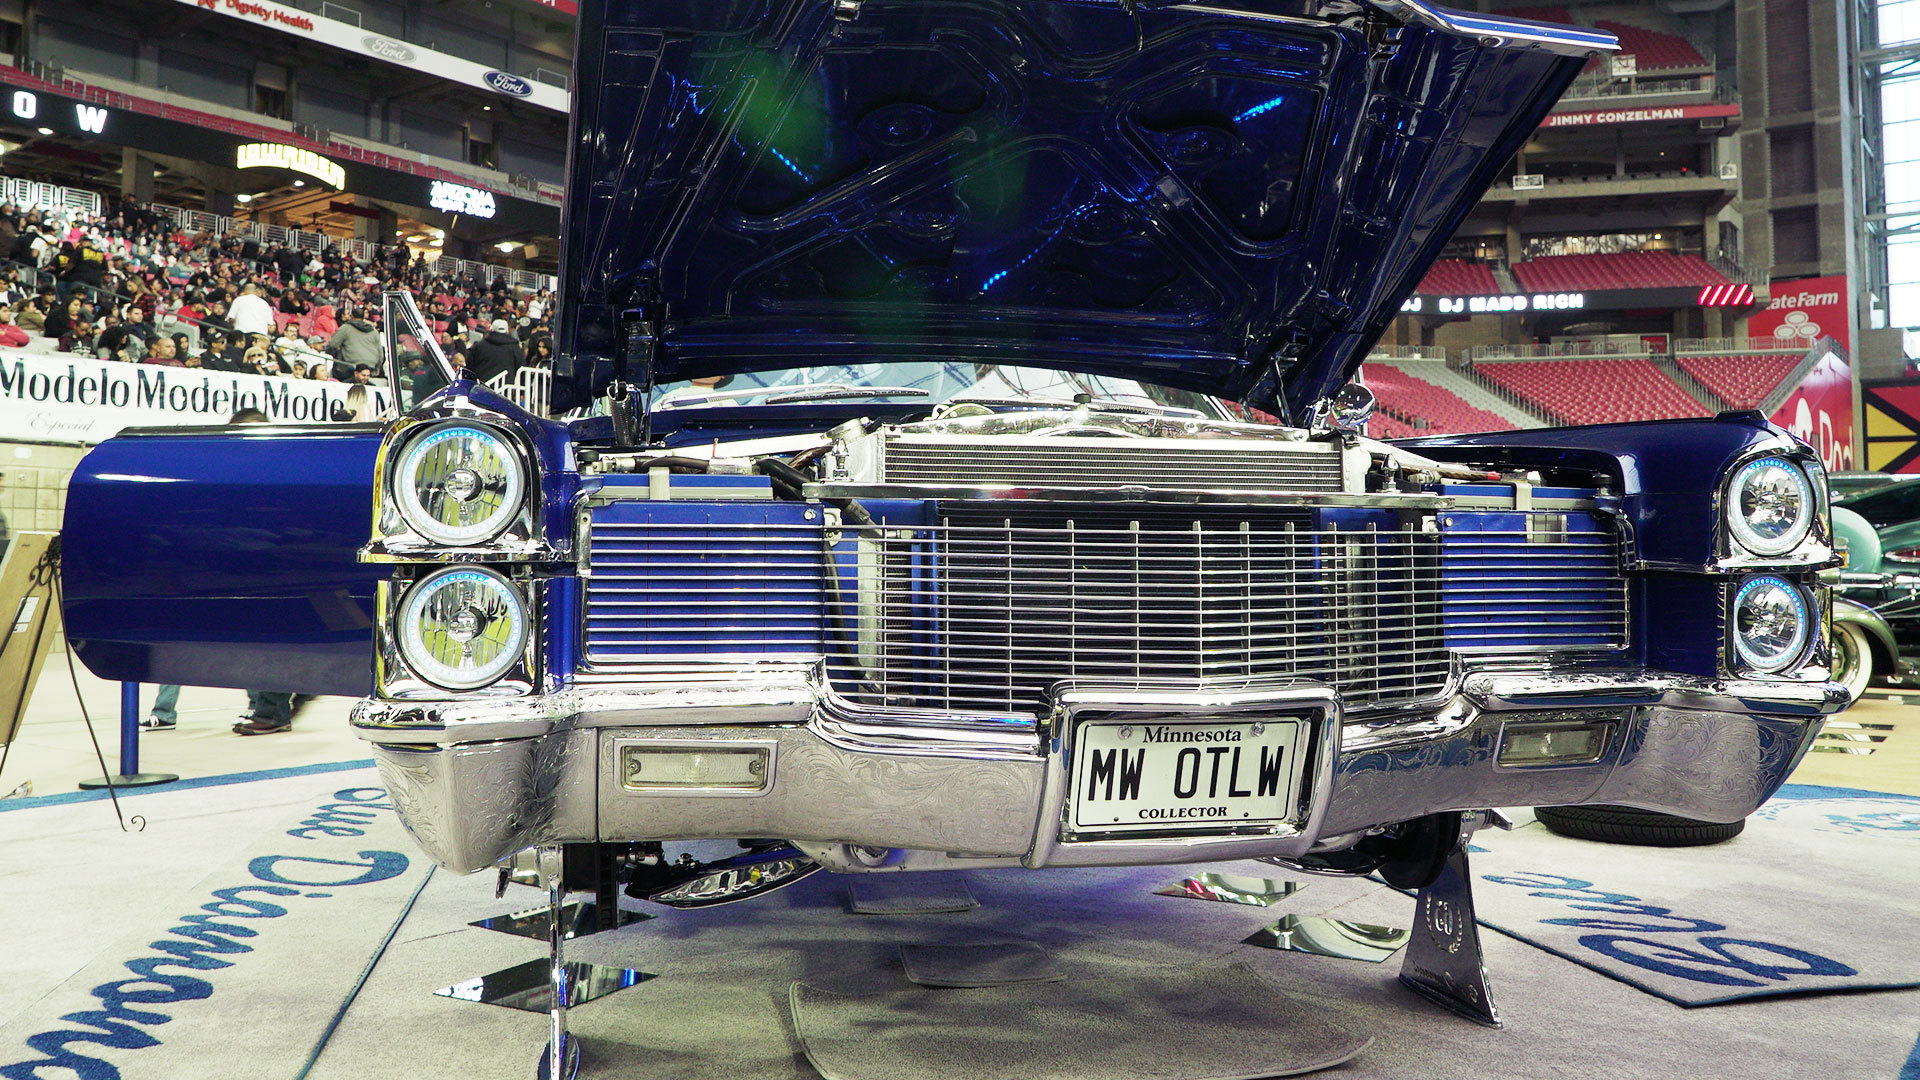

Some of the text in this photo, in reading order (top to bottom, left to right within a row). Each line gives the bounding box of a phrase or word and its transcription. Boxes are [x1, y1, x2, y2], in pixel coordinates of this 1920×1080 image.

[226, 0, 314, 31] Dignity Health
[371, 37, 407, 61] Ford
[493, 74, 524, 94] Ford
[1549, 109, 1684, 127] JIMMY CONZELMAN
[1533, 293, 1584, 310] RICH
[1766, 292, 1839, 310] ateFarm
[0, 356, 130, 408] Modelo
[137, 368, 258, 415] Modelo
[263, 380, 345, 422] Mode
[1142, 725, 1242, 743] Minnesota
[1087, 748, 1146, 801] MW
[1138, 806, 1228, 819] COLLECTOR
